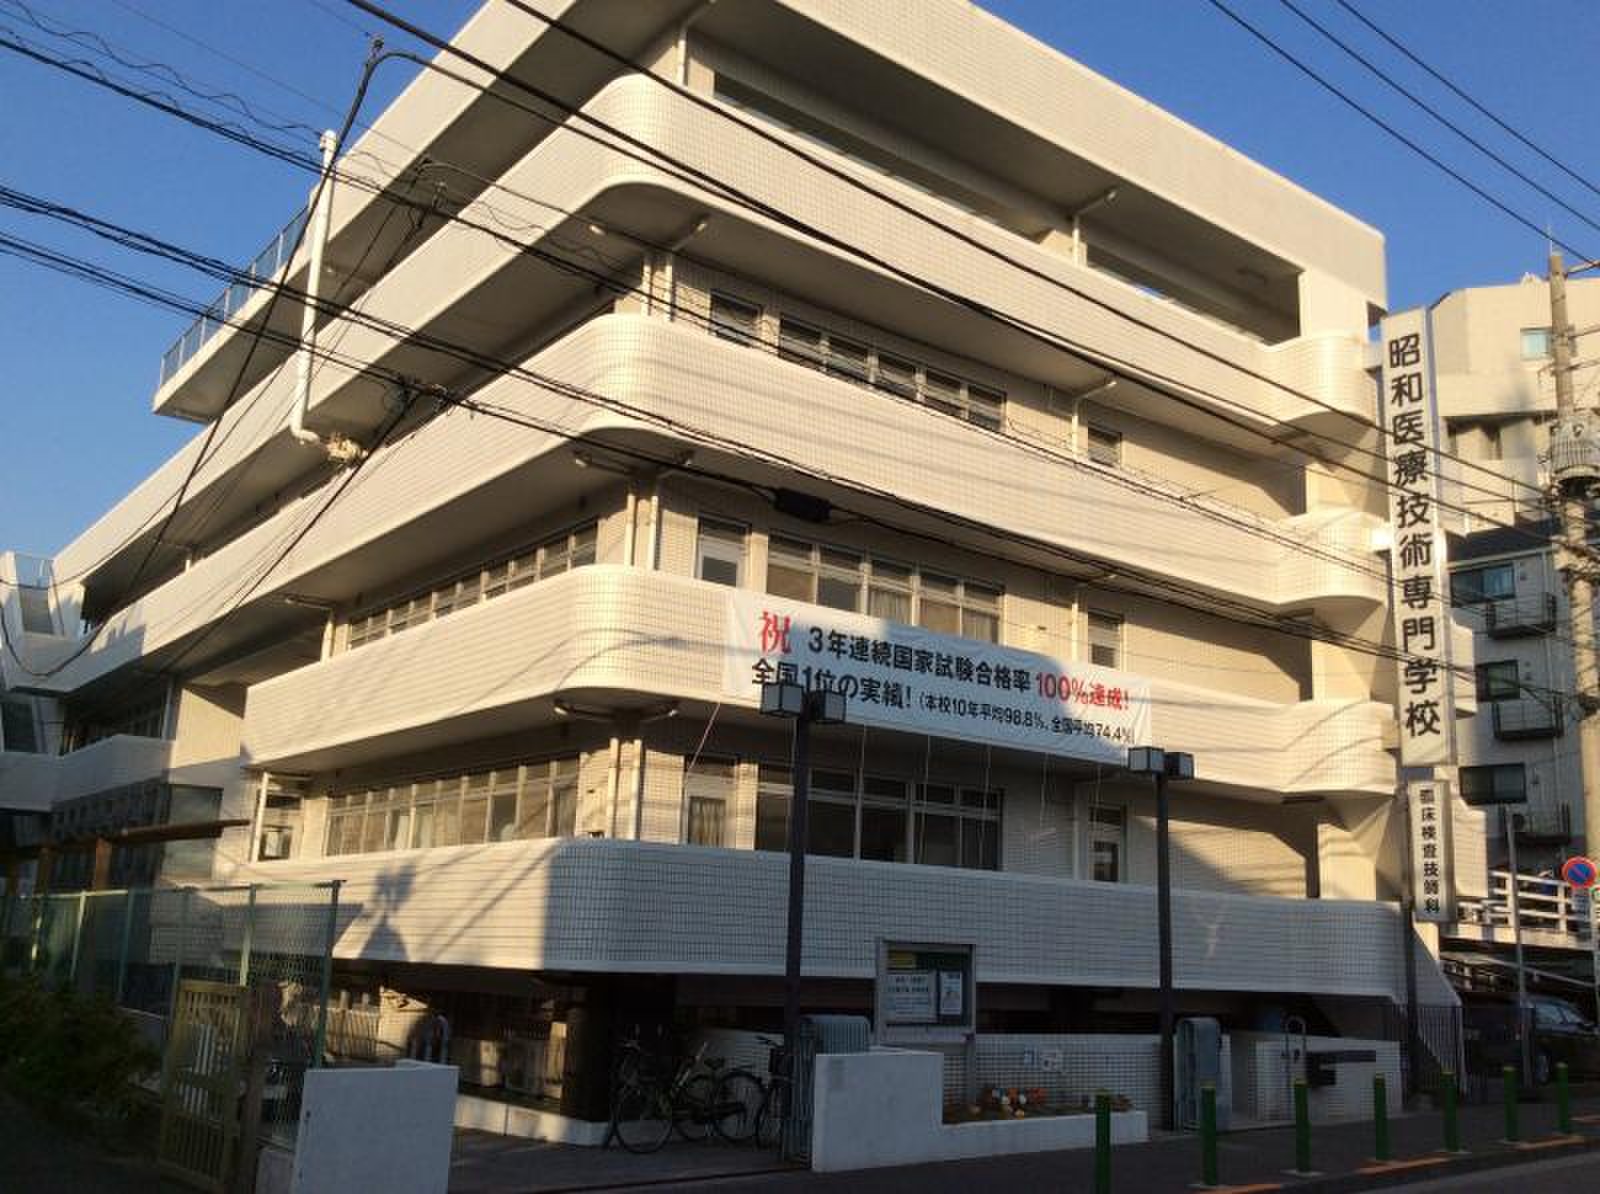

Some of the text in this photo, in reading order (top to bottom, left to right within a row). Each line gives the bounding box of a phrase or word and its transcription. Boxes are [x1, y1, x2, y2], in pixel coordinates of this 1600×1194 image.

[758, 611, 792, 654] 祝
[1388, 333, 1441, 737] 昭和医療技術専門学校
